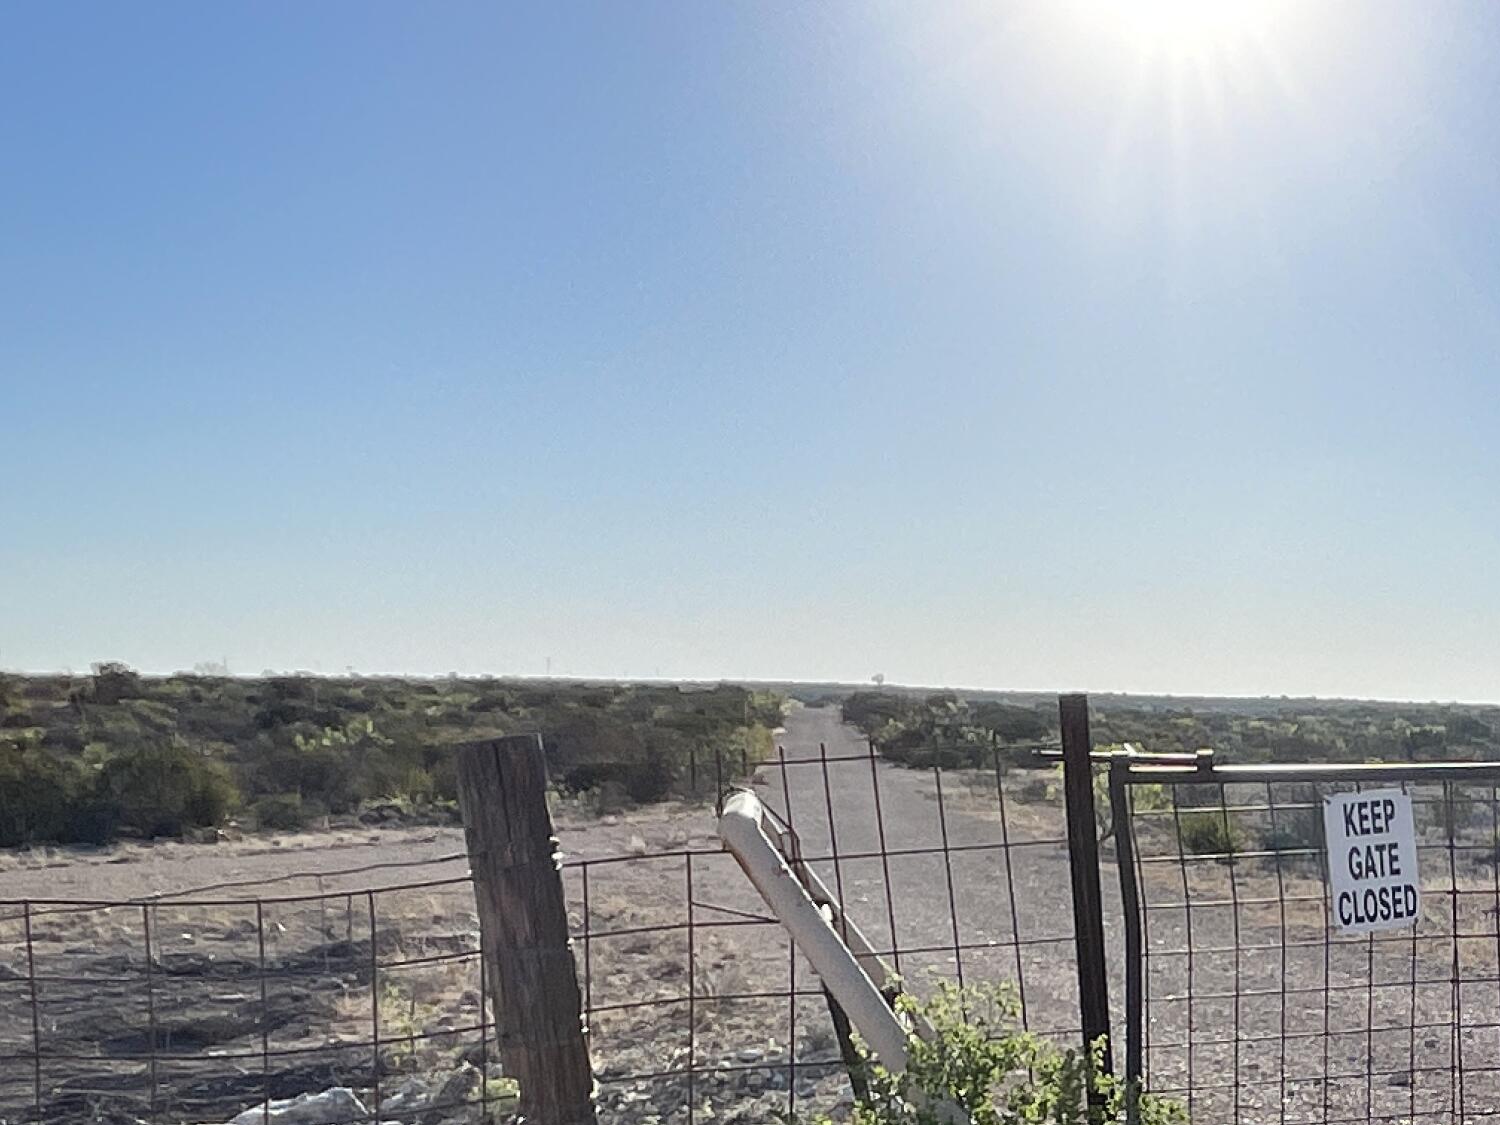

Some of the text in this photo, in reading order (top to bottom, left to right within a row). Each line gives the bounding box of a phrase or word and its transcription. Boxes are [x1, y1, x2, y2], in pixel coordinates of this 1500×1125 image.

[1342, 799, 1395, 837] KEEP
[1348, 842, 1401, 881] GATE
[1338, 884, 1417, 926] CLOSED
